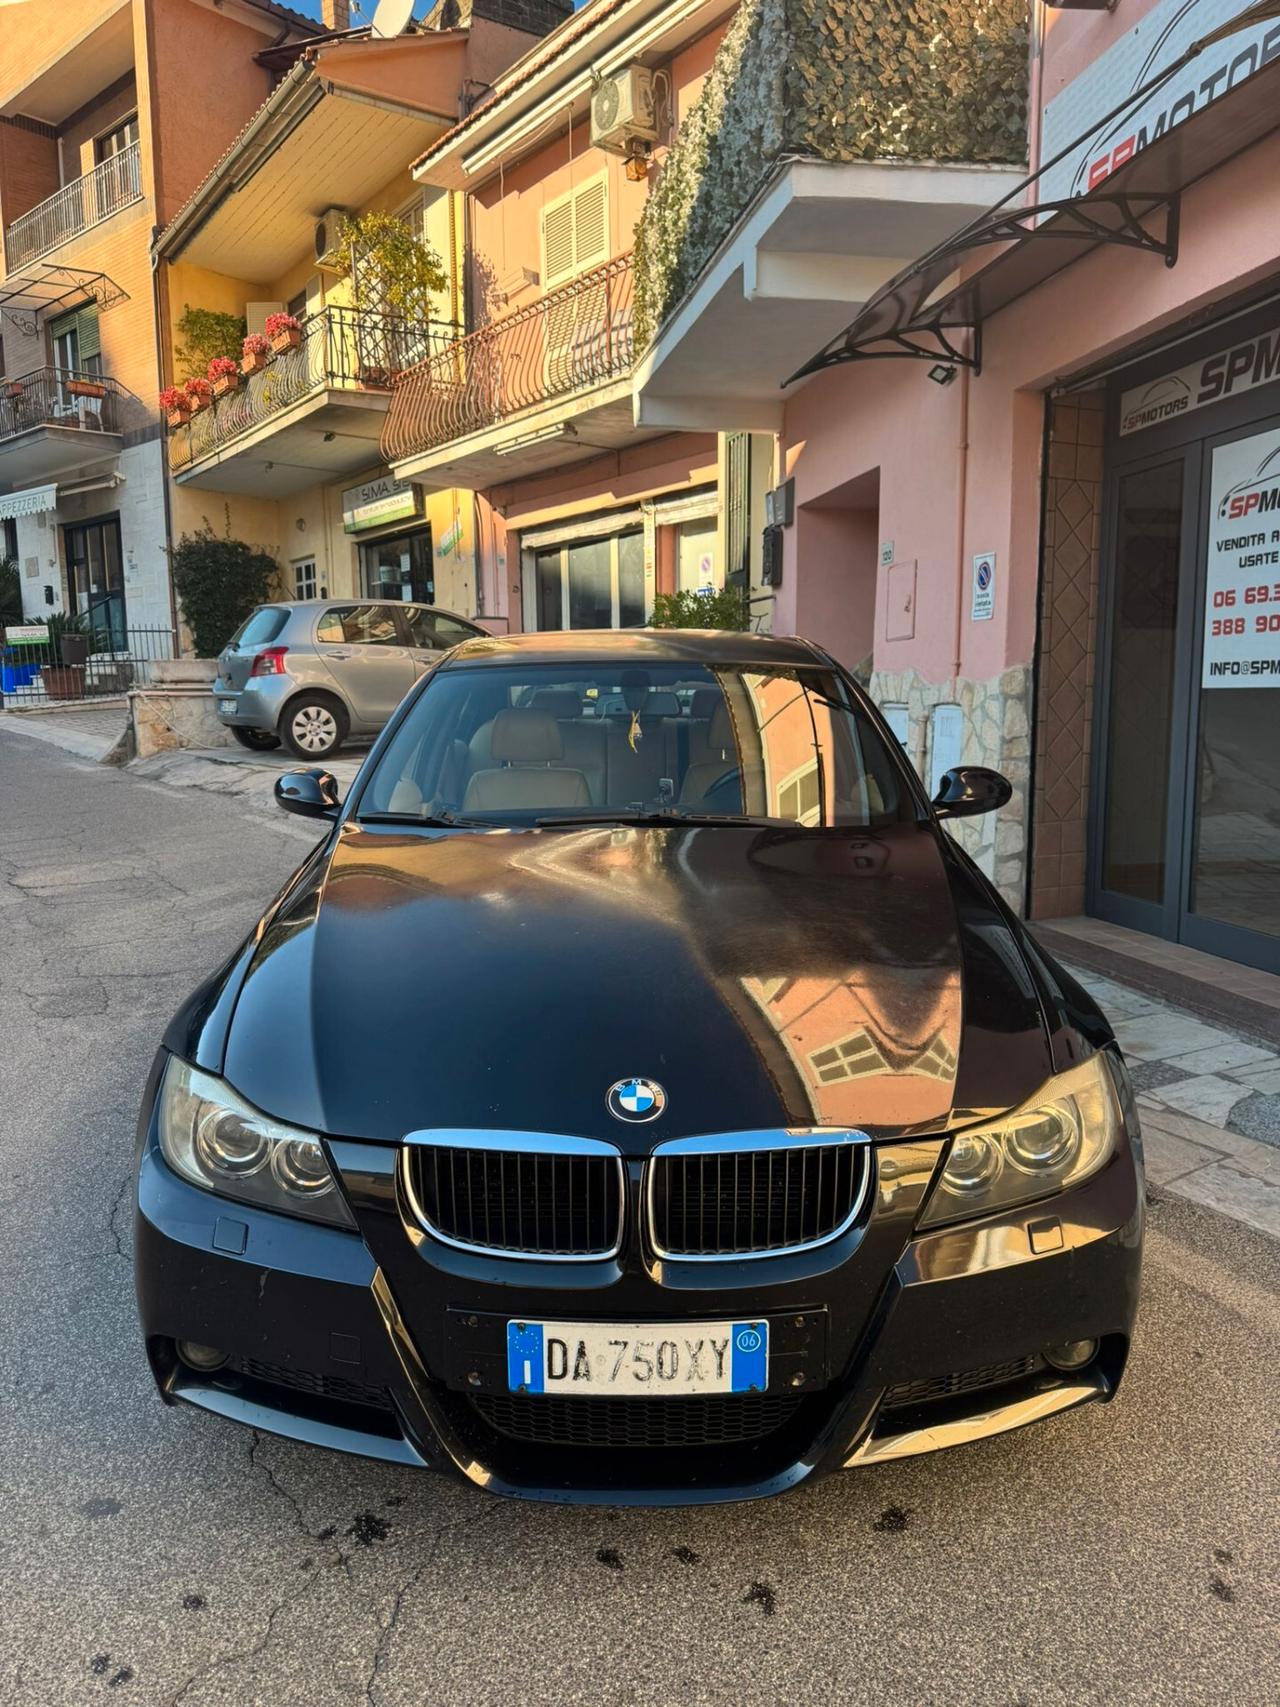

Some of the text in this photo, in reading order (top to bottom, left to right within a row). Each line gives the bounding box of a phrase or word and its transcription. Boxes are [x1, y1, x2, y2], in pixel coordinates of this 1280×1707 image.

[1127, 395, 1189, 430] SPMOTORS
[0, 495, 46, 515] PPEZZERIA
[1228, 487, 1280, 520] SPM
[1216, 533, 1266, 552] VENDITA
[1239, 551, 1279, 568] USATE
[1213, 589, 1236, 608] 06
[1212, 617, 1245, 636] 388
[547, 1338, 593, 1382] DA
[608, 1338, 730, 1383] 750XY
[741, 1334, 756, 1348] 06
